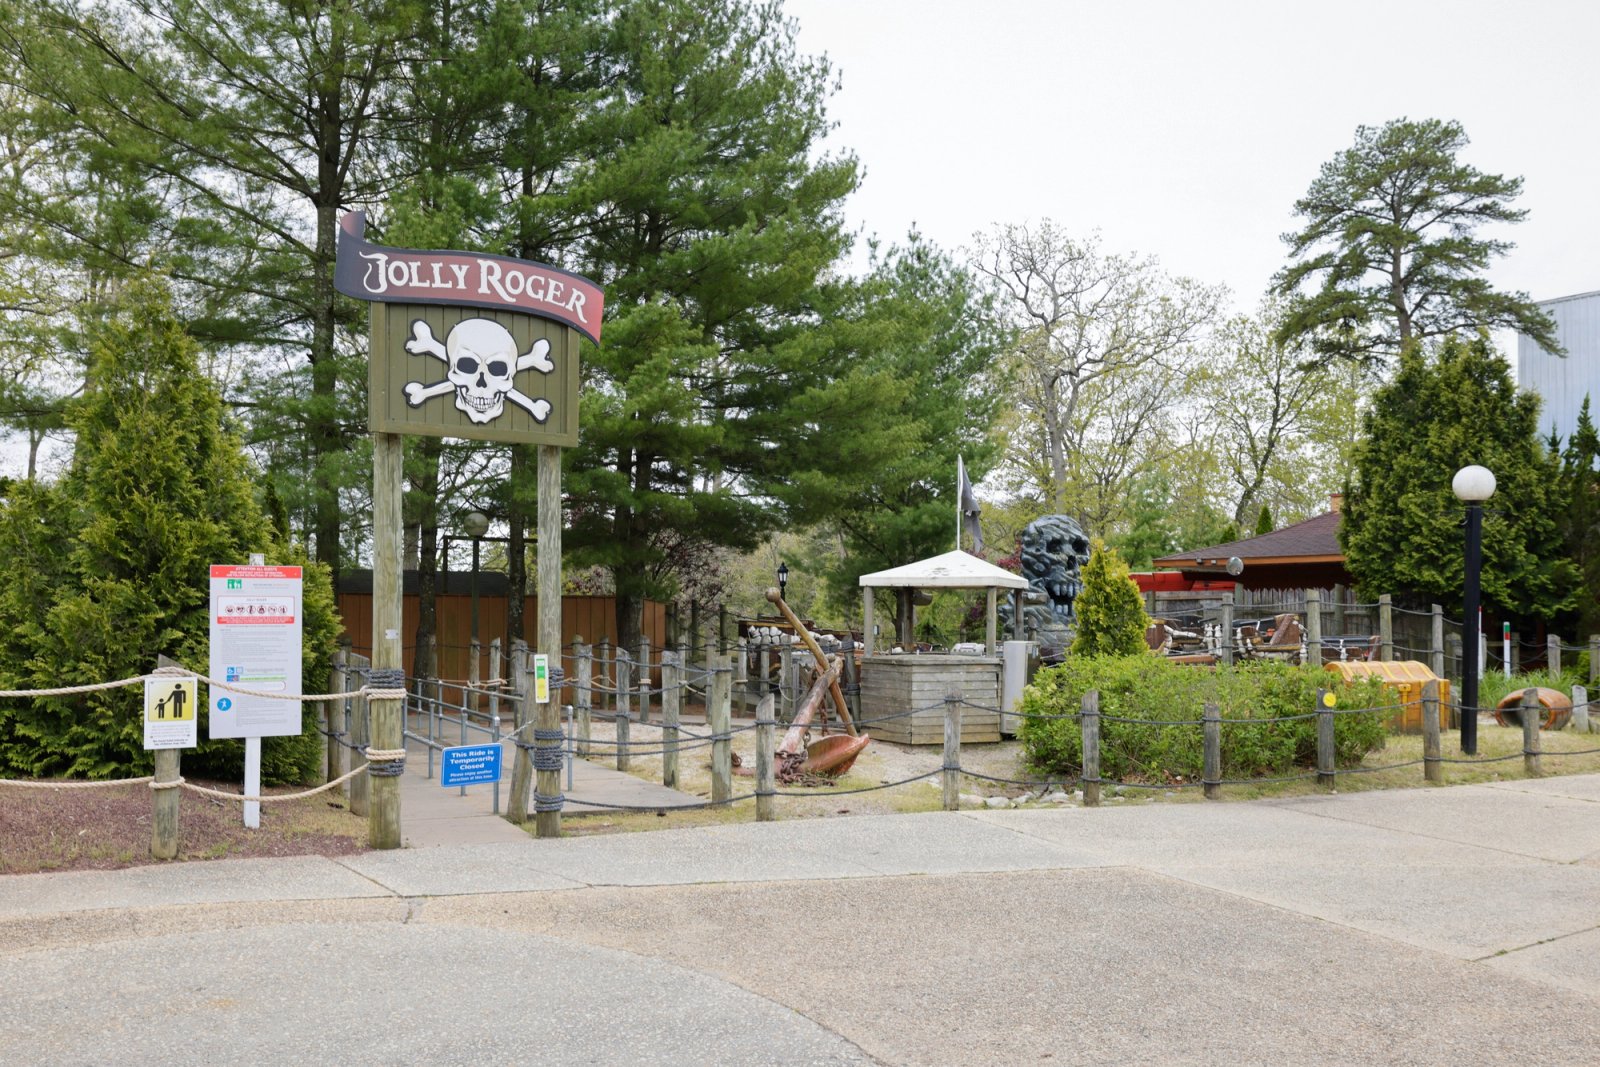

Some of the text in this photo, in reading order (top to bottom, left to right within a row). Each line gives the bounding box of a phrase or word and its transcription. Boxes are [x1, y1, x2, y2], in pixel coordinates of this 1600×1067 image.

[359, 251, 588, 324] JOLLY ROGER
[450, 756, 494, 764] Temporarily
